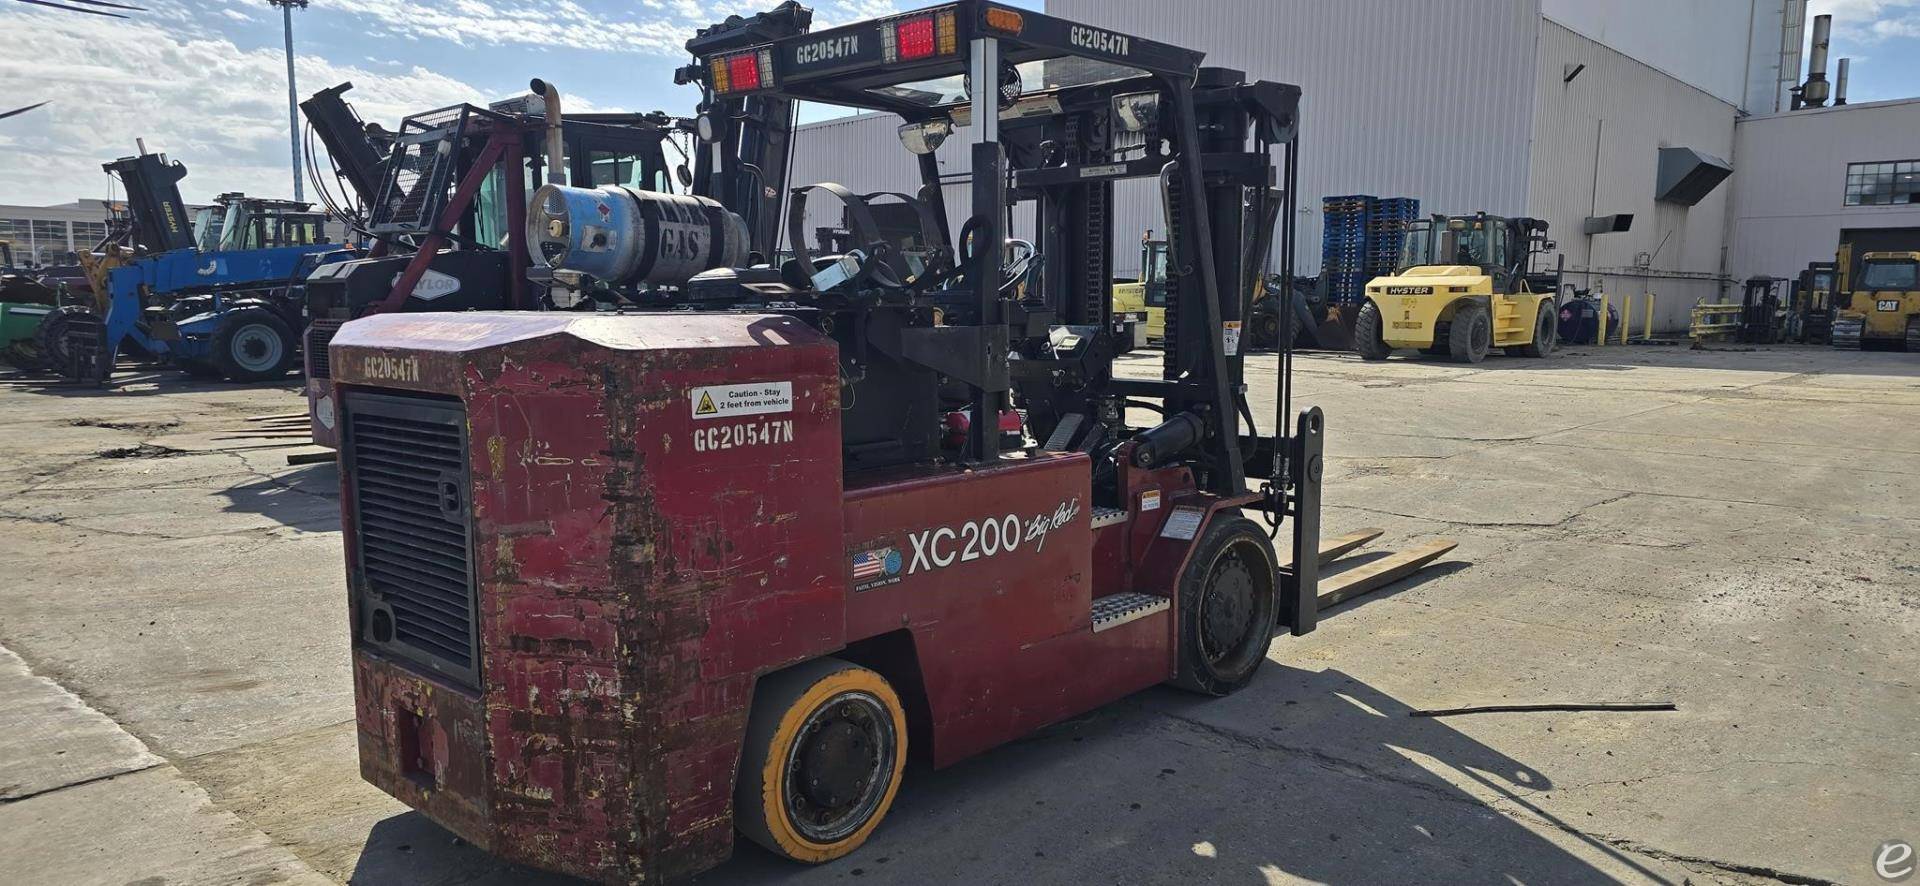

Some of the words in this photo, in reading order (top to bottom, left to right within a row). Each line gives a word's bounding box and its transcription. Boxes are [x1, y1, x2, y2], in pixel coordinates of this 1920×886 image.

[796, 35, 858, 64] GC20547N
[1071, 26, 1129, 56] GC20547N
[1878, 300, 1898, 311] CAT
[364, 355, 419, 382] GC20547N
[720, 401, 726, 409] 2
[727, 401, 742, 409] feet
[744, 400, 762, 408] from
[763, 398, 789, 406] vehicle
[728, 390, 758, 398] Caution
[764, 389, 781, 397] Stay
[694, 420, 793, 452] GC20547N
[907, 513, 1021, 575] XC200
